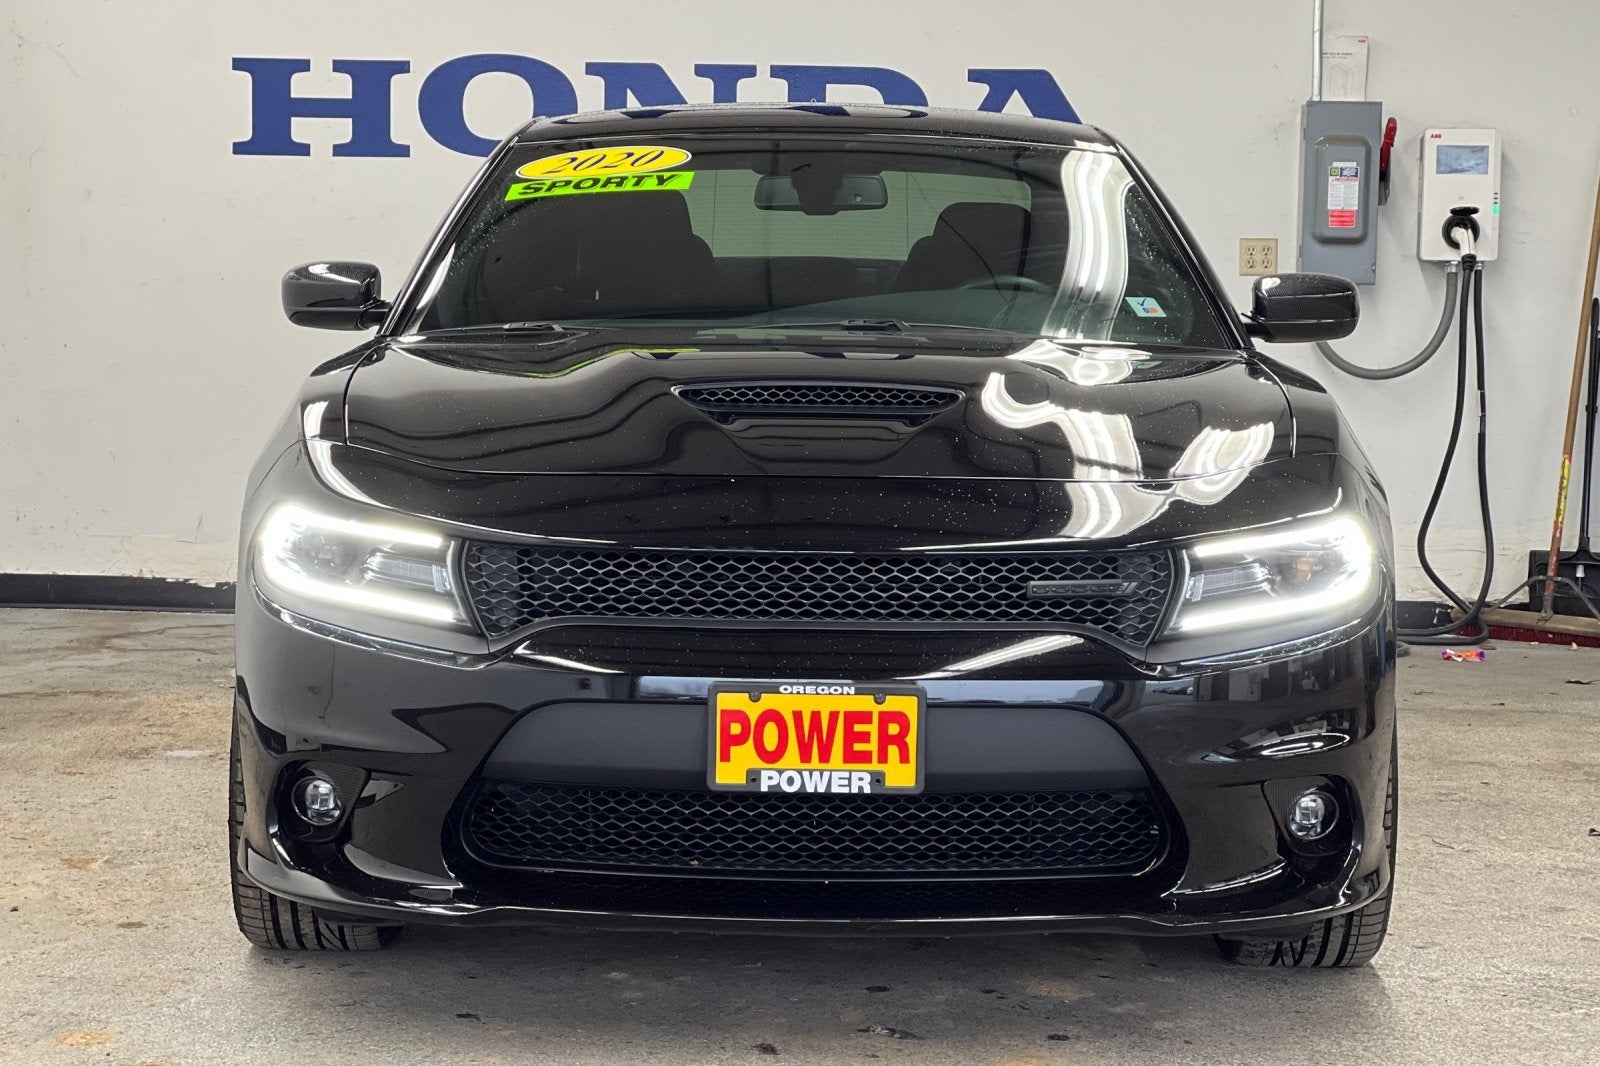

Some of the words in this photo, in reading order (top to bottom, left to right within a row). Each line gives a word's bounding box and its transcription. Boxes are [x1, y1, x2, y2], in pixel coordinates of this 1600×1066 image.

[540, 149, 665, 175] 2020
[518, 173, 681, 196] SPORTY
[779, 685, 856, 695] OREGON
[719, 708, 911, 765] POWER
[760, 770, 872, 794] POWER
